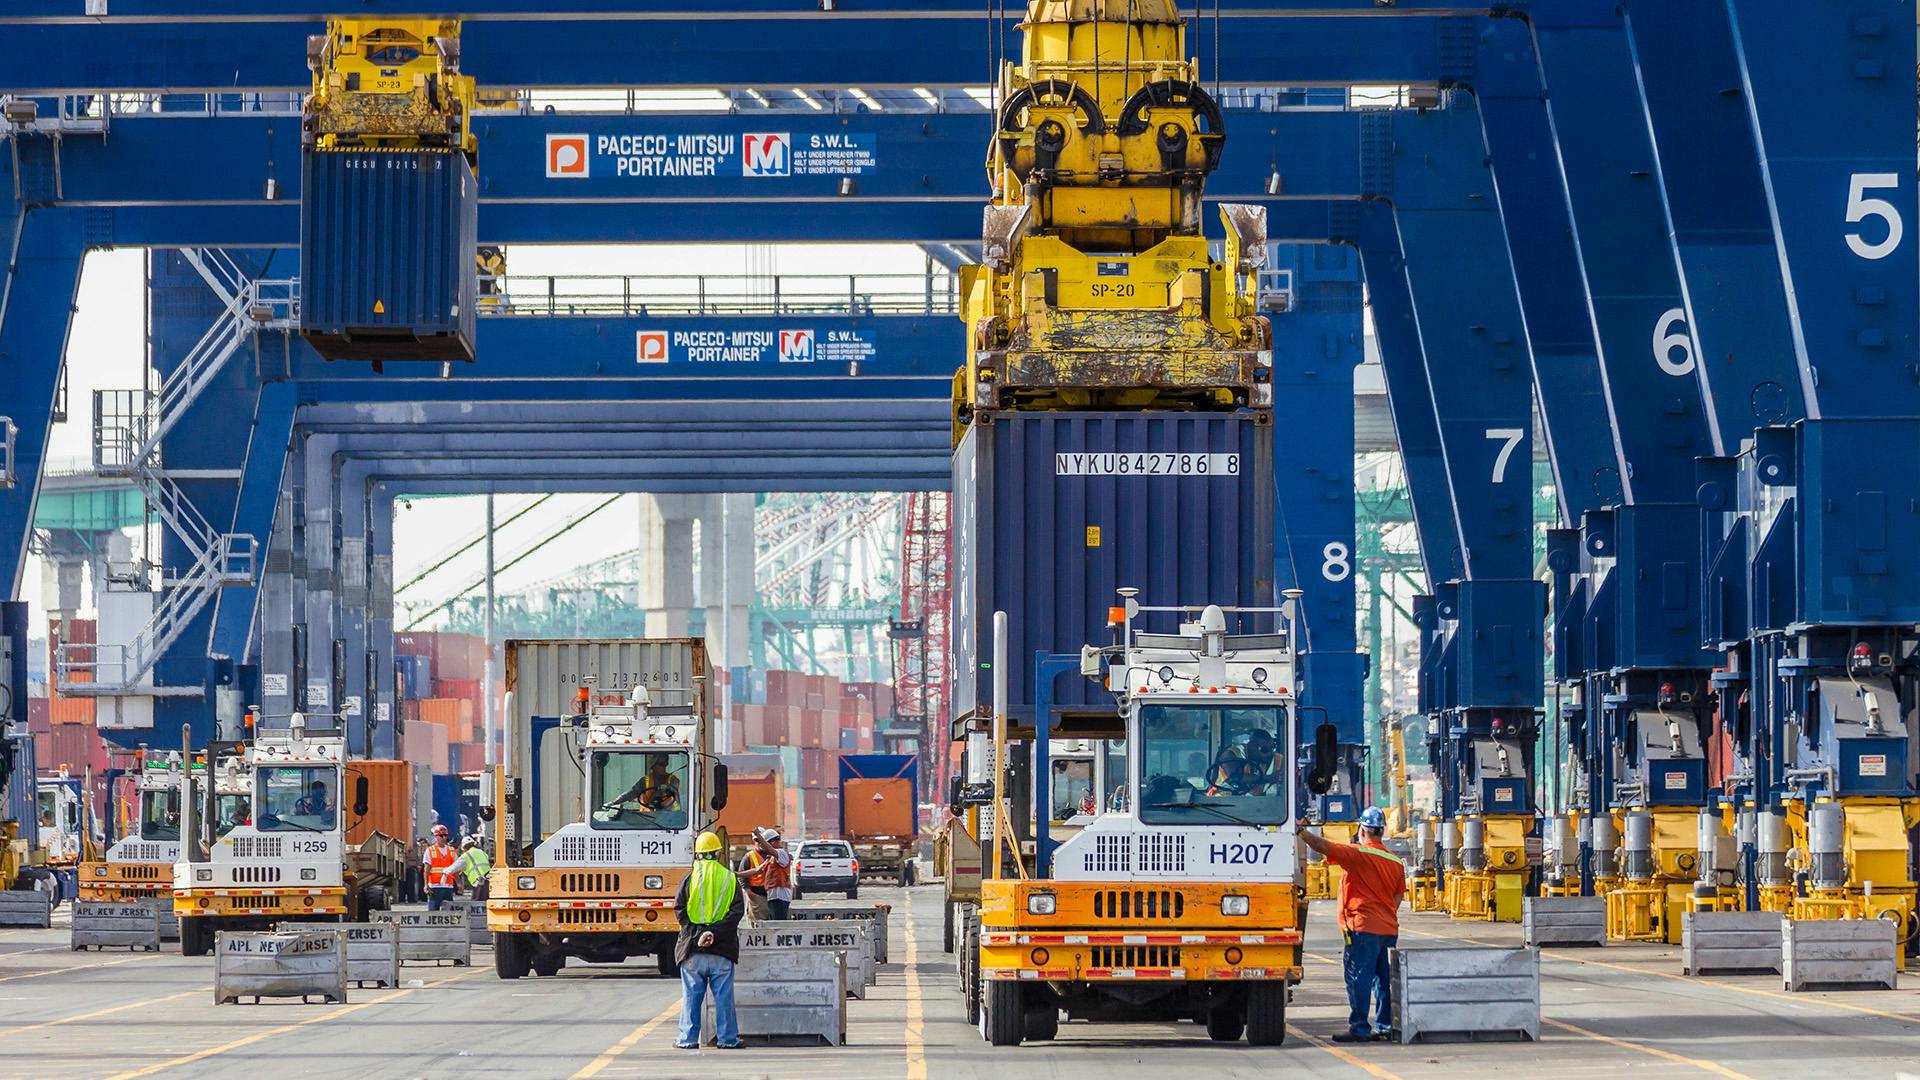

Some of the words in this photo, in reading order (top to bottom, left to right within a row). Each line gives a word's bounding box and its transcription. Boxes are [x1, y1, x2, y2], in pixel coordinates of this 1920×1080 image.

[376, 80, 401, 89] SP-23
[597, 135, 734, 155] PACECO-MITSUI
[810, 135, 858, 148] S.W.L.
[1843, 172, 1904, 260] 5
[1091, 283, 1135, 297] SP-20
[673, 331, 774, 346] PACECO-MITSUI
[1652, 307, 1696, 376] 6
[1485, 428, 1524, 483] 7
[1056, 454, 1208, 474] NYKU842786
[1321, 541, 1351, 582] 8
[640, 841, 672, 855] H211
[1209, 843, 1274, 865] H207
[77, 908, 93, 916] APL
[119, 908, 151, 917] JERSEY
[400, 915, 420, 925] NEW
[425, 915, 462, 925] JERSEY
[347, 928, 384, 940] ERSEY
[745, 934, 770, 946] APL
[777, 934, 803, 946] NEW
[809, 933, 856, 946] JERSEY
[228, 939, 252, 952] APL
